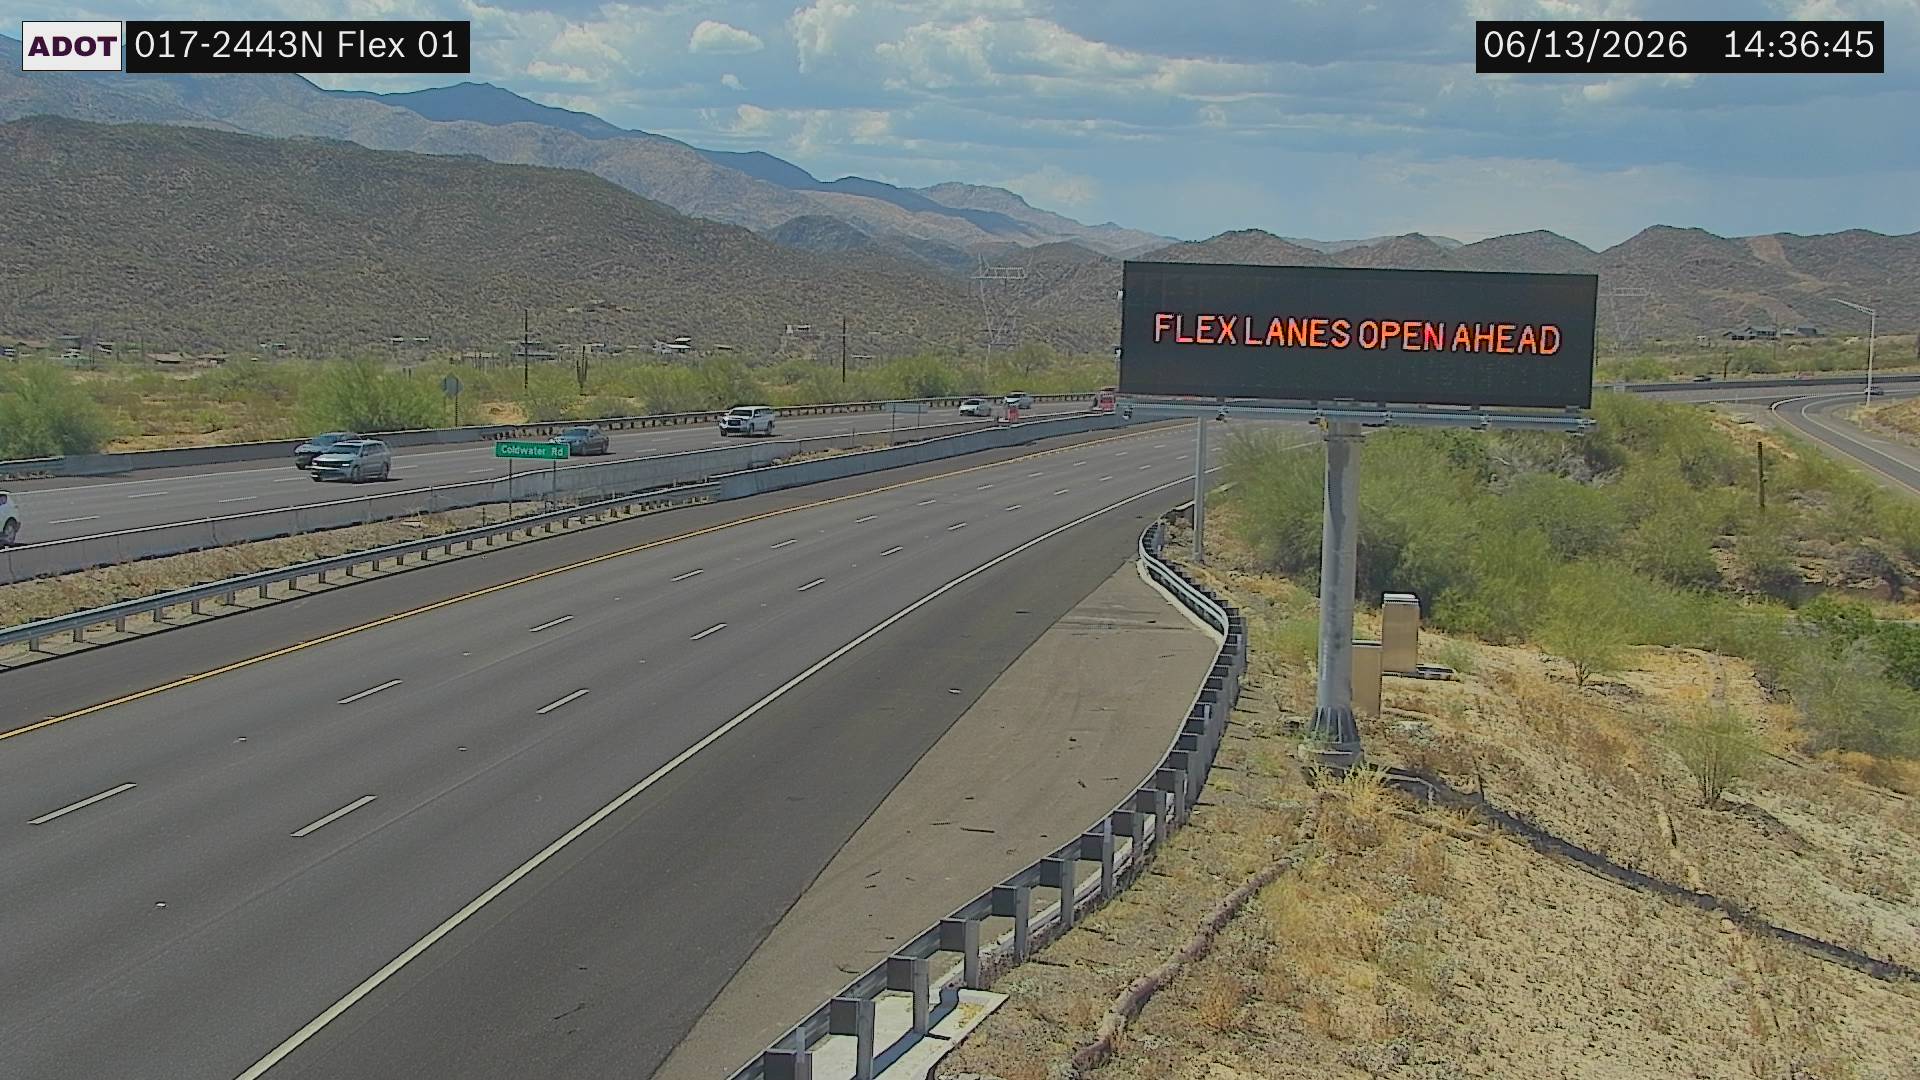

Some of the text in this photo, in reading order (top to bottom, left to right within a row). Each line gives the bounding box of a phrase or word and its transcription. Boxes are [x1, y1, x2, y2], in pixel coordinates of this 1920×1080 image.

[1154, 313, 1560, 355] FLEX LANES OPEN AHEAD
[501, 444, 564, 457] Coldwater Rd
